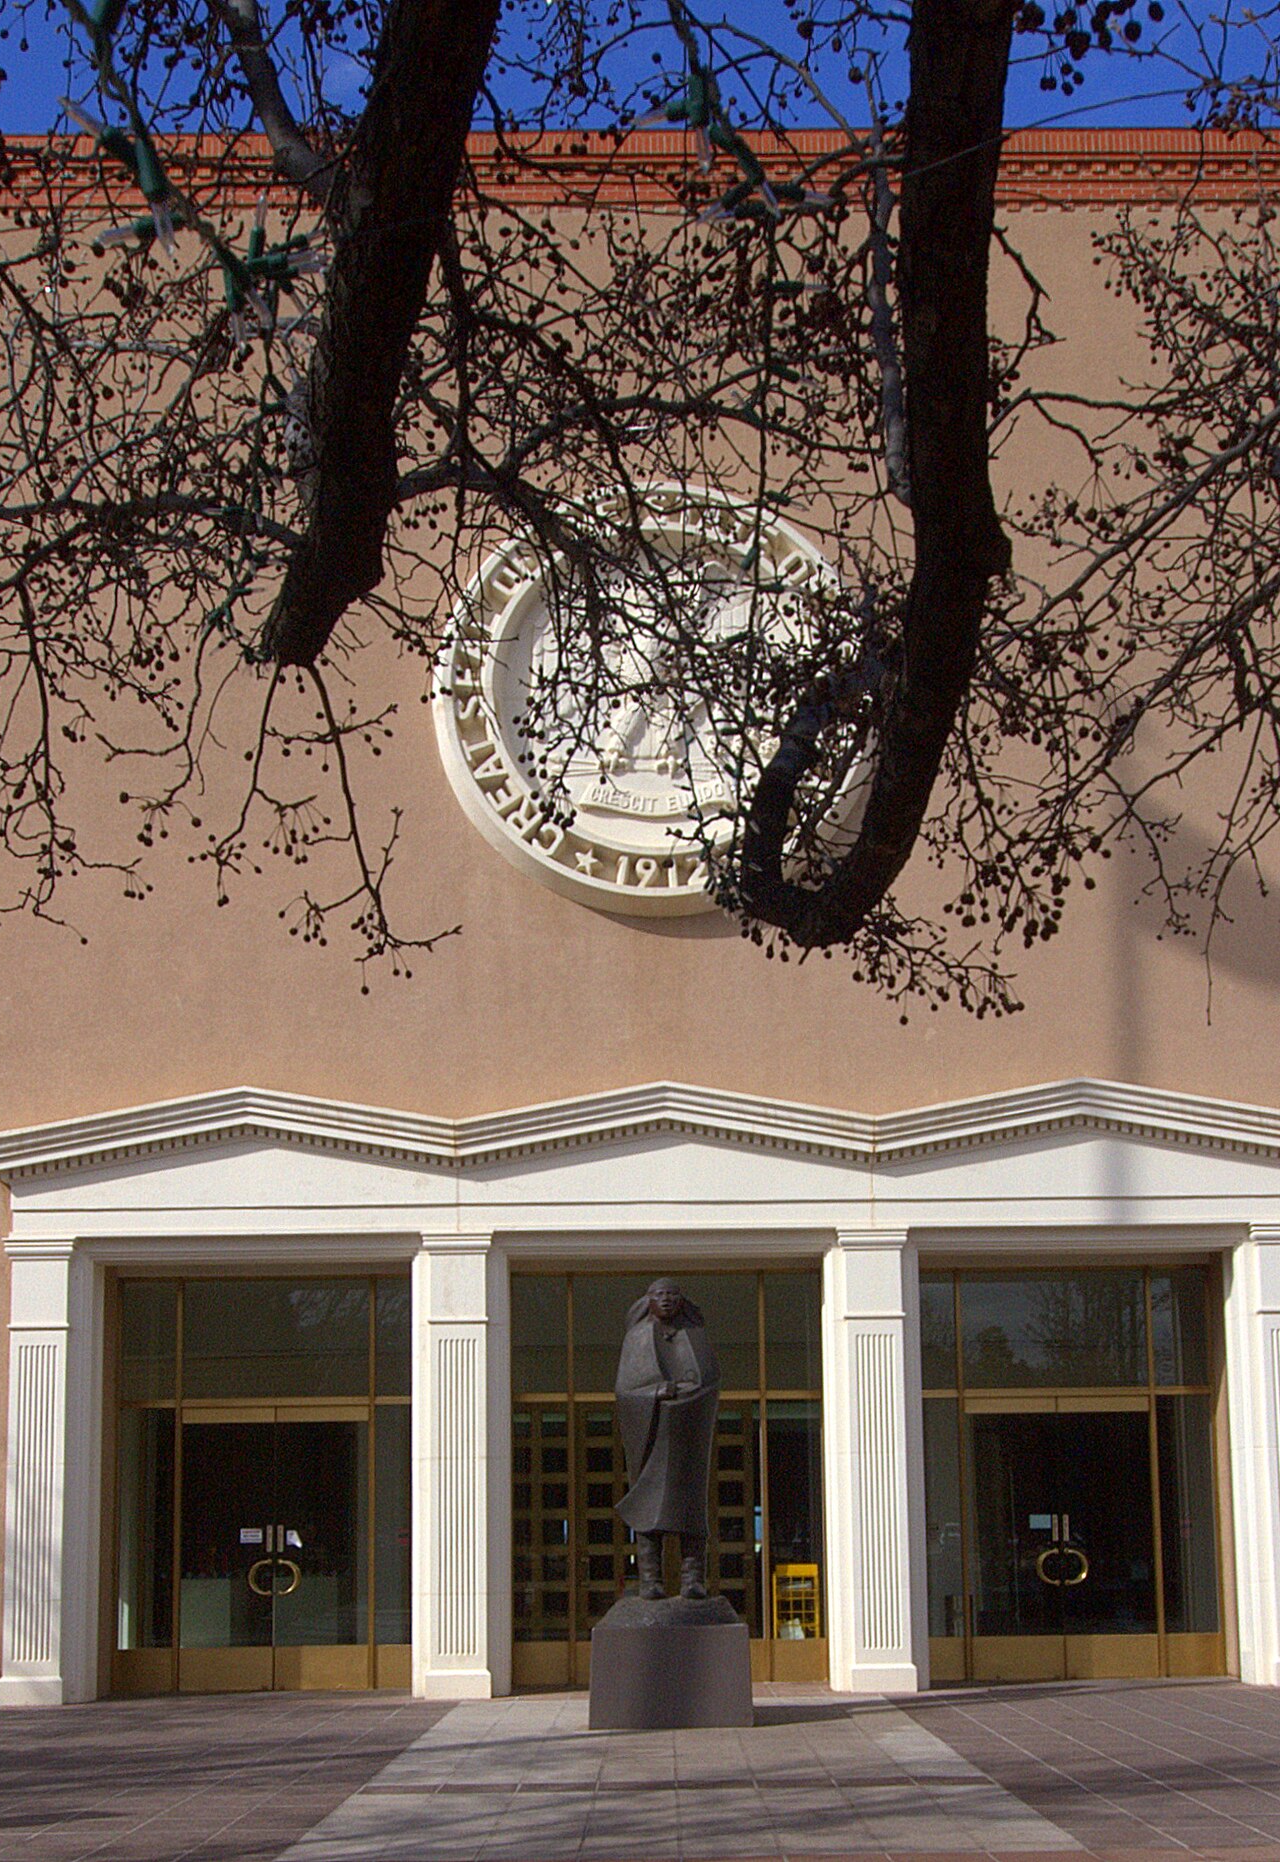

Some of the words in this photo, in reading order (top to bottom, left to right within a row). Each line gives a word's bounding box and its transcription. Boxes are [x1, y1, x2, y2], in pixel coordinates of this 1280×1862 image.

[453, 612, 503, 720] SEAL
[460, 739, 564, 856] GREAT
[591, 786, 658, 812] CRESCIT
[616, 855, 710, 887] 1912
